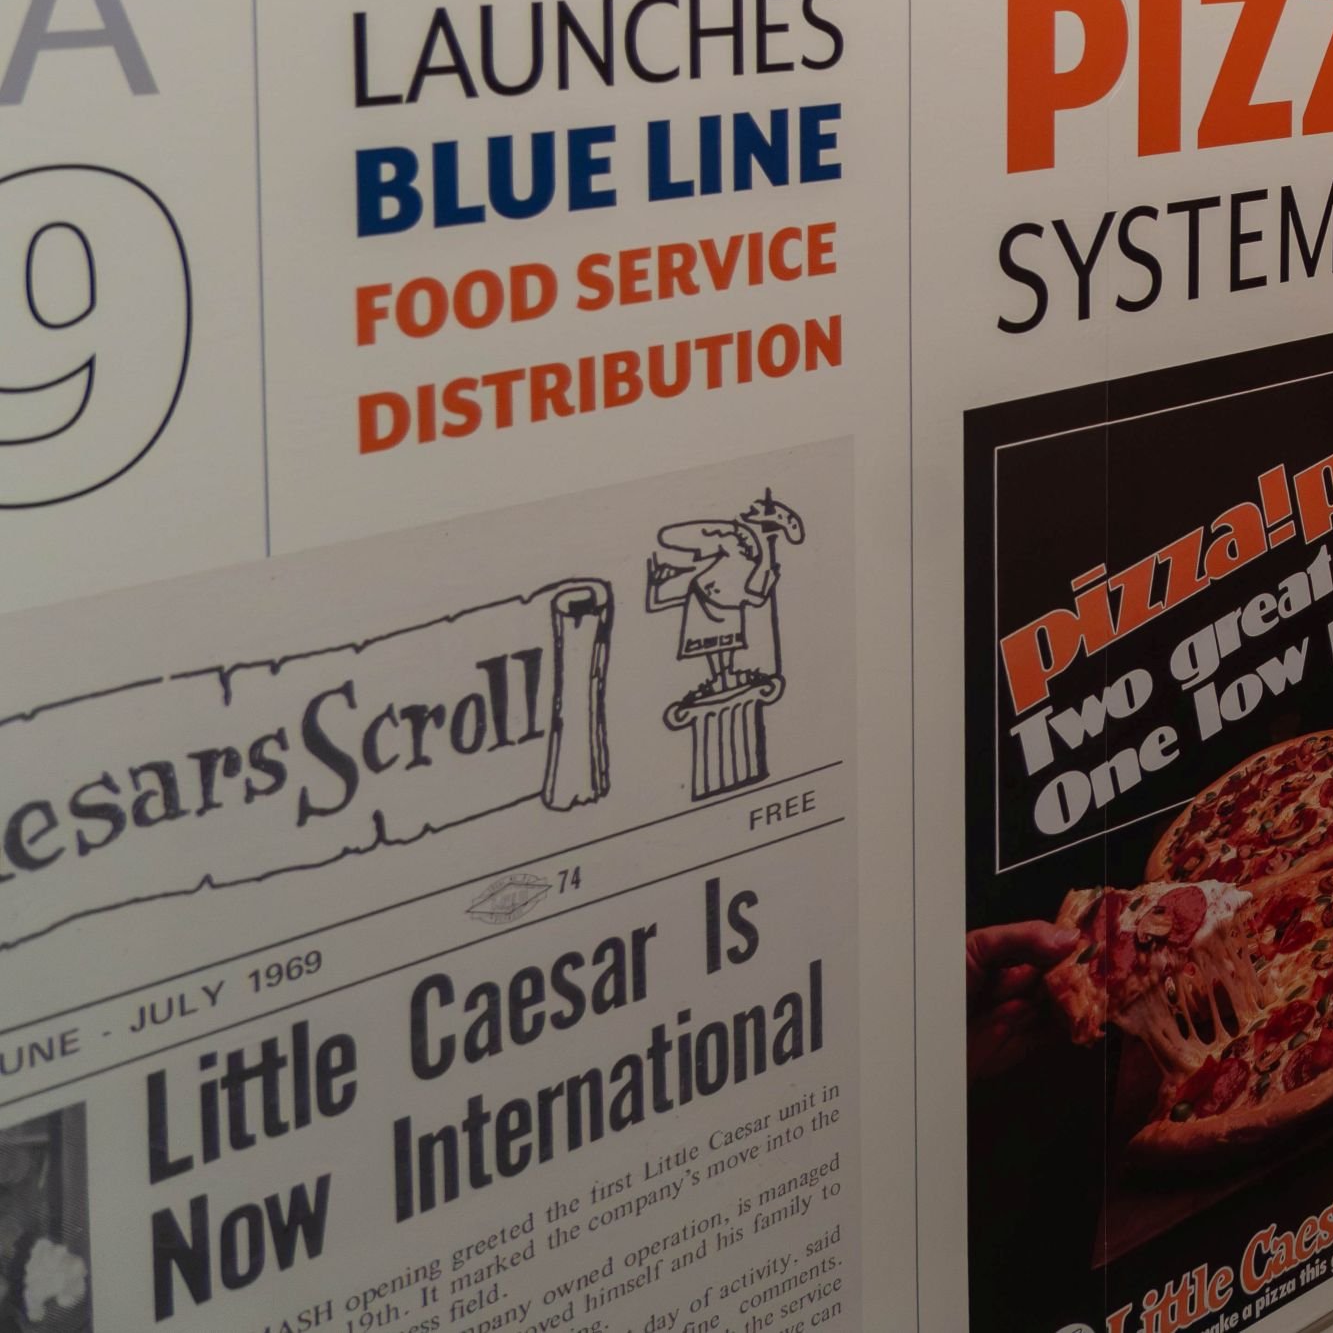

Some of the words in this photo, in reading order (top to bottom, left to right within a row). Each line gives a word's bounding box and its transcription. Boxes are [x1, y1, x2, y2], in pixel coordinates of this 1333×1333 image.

[355, 125, 617, 237] BLUE
[647, 102, 842, 201] LINE
[355, 262, 558, 346] FOOD
[575, 222, 837, 312] SERVICE
[357, 315, 843, 455] DISTRIBUTION
[1011, 668, 1154, 776] Two
[1034, 725, 1180, 836] One
[1193, 636, 1310, 742] low
[749, 789, 816, 830] FREE
[558, 866, 582, 894] 74
[130, 980, 225, 1033] JULY
[248, 950, 323, 994] 1969
[146, 1020, 358, 1185] Little
[409, 922, 658, 1082] Caesar
[705, 877, 760, 974] Is
[150, 1173, 332, 1324] Now
[394, 960, 823, 1223] International
[452, 1213, 535, 1269] greeted
[645, 1146, 699, 1181] Little
[709, 1115, 770, 1151] Caesar
[624, 1212, 730, 1278] operation,
[758, 1153, 841, 1206] managed
[753, 1190, 812, 1234] family
